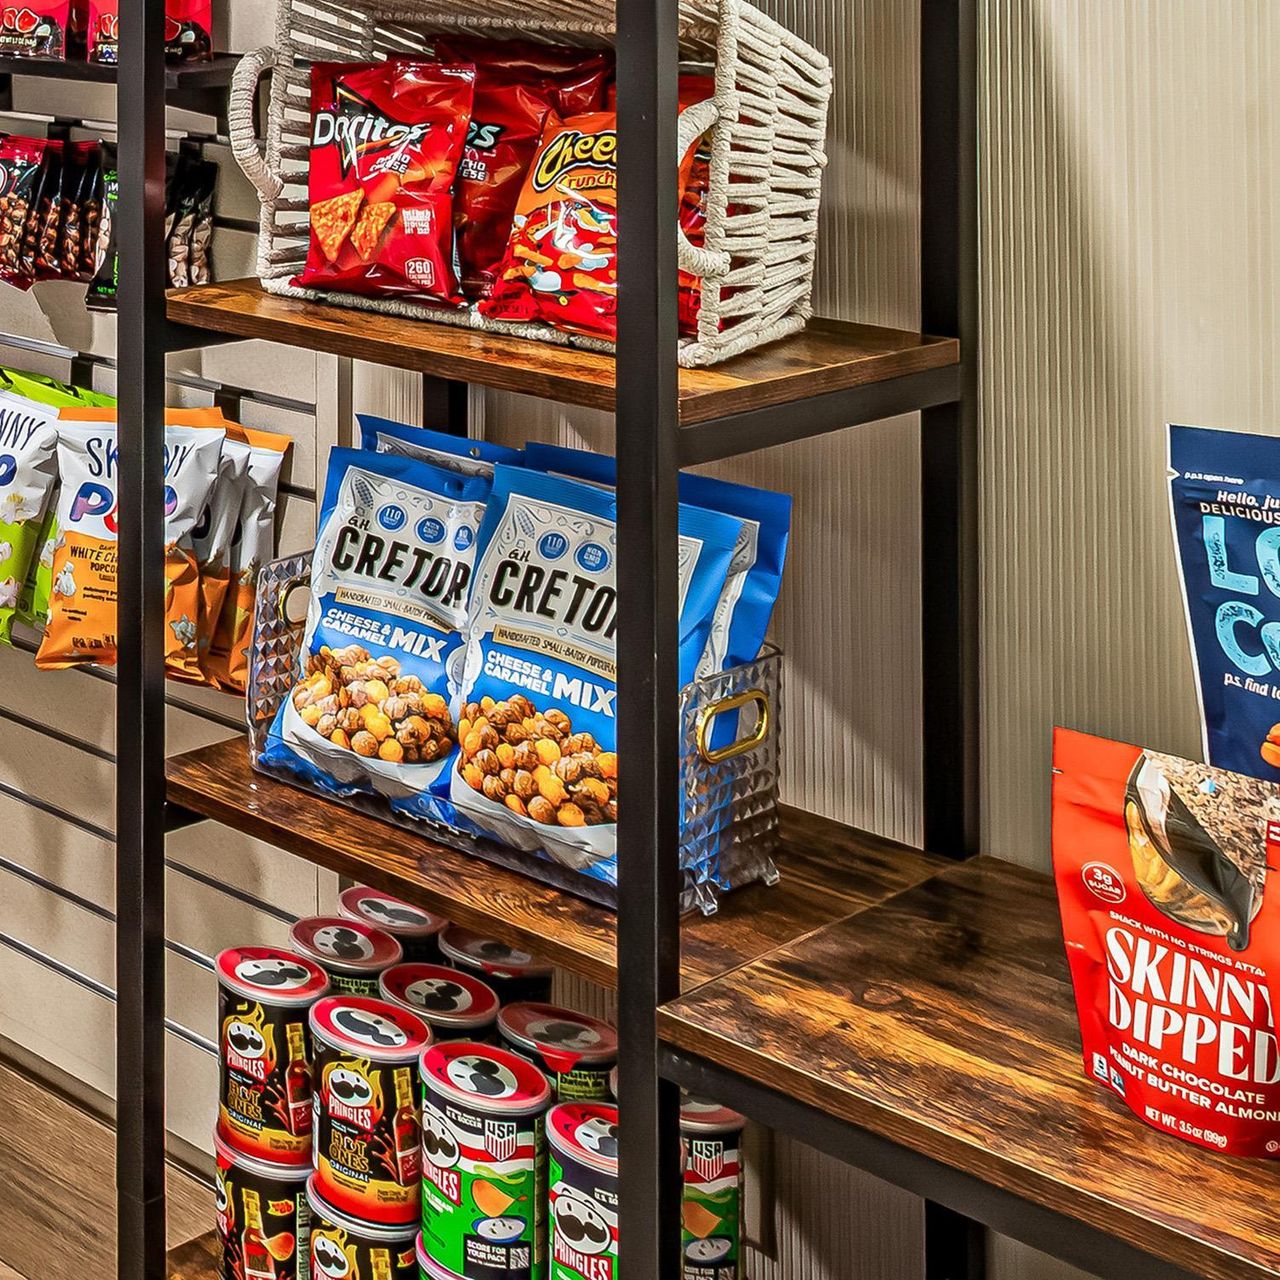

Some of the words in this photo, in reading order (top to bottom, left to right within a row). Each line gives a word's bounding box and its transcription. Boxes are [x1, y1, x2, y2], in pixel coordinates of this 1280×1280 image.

[313, 112, 432, 147] Doritos
[407, 260, 431, 275] 260
[1203, 473, 1223, 484] open
[1224, 476, 1243, 486] here
[1217, 490, 1259, 508] Hello.
[385, 507, 400, 520] 110
[70, 545, 103, 561] WHITE
[547, 535, 564, 549] 110
[90, 561, 118, 574] POPCO
[340, 590, 381, 605] HANDCRAFTED
[382, 598, 424, 620] SMALL-BATCH
[321, 619, 387, 646] CARAMEL
[327, 609, 382, 633] CHEESE
[388, 626, 448, 662] MIX
[498, 629, 540, 648] HANDCRAFTED
[541, 637, 587, 662] SMALL-BATCH
[487, 651, 543, 677] CHEESE
[483, 663, 550, 696] CARAMEL
[1244, 677, 1269, 696] find
[552, 674, 617, 718] MIX
[1088, 878, 1122, 896] SUGAR
[1093, 867, 1112, 886] 3g
[1109, 909, 1143, 930] SNACK
[1143, 924, 1170, 942] WITH
[1170, 936, 1186, 948] NO
[1188, 943, 1233, 966] STRINGS
[1105, 926, 1276, 1028] SKINNY
[1108, 978, 1280, 1085] DIPPED
[227, 1053, 265, 1081] PRINGLES
[1109, 1045, 1146, 1082] PEANUT
[1147, 1074, 1212, 1109] BUTTER
[1122, 1041, 1159, 1069] DARK
[1161, 1060, 1266, 1105] CHOCOLATE
[228, 1093, 262, 1120] ONES
[228, 1108, 262, 1131] ORIGINAL
[328, 1097, 372, 1130] PRINGLES
[485, 1122, 516, 1139] USA
[1145, 1104, 1160, 1121] NET
[1161, 1113, 1179, 1131] WT.
[1179, 1118, 1192, 1135] 3.5
[1192, 1126, 1202, 1140] oz
[1203, 1128, 1228, 1149] (99g)
[331, 1128, 368, 1154] HOT
[694, 1141, 723, 1158] USA
[328, 1143, 369, 1173] ONES
[329, 1159, 369, 1183] ORIGINAL
[467, 1238, 490, 1254] SCORE
[491, 1245, 506, 1256] FOR
[467, 1247, 483, 1259] YOUR
[484, 1251, 506, 1264] PACK
[554, 1229, 609, 1280] PRINGLES
